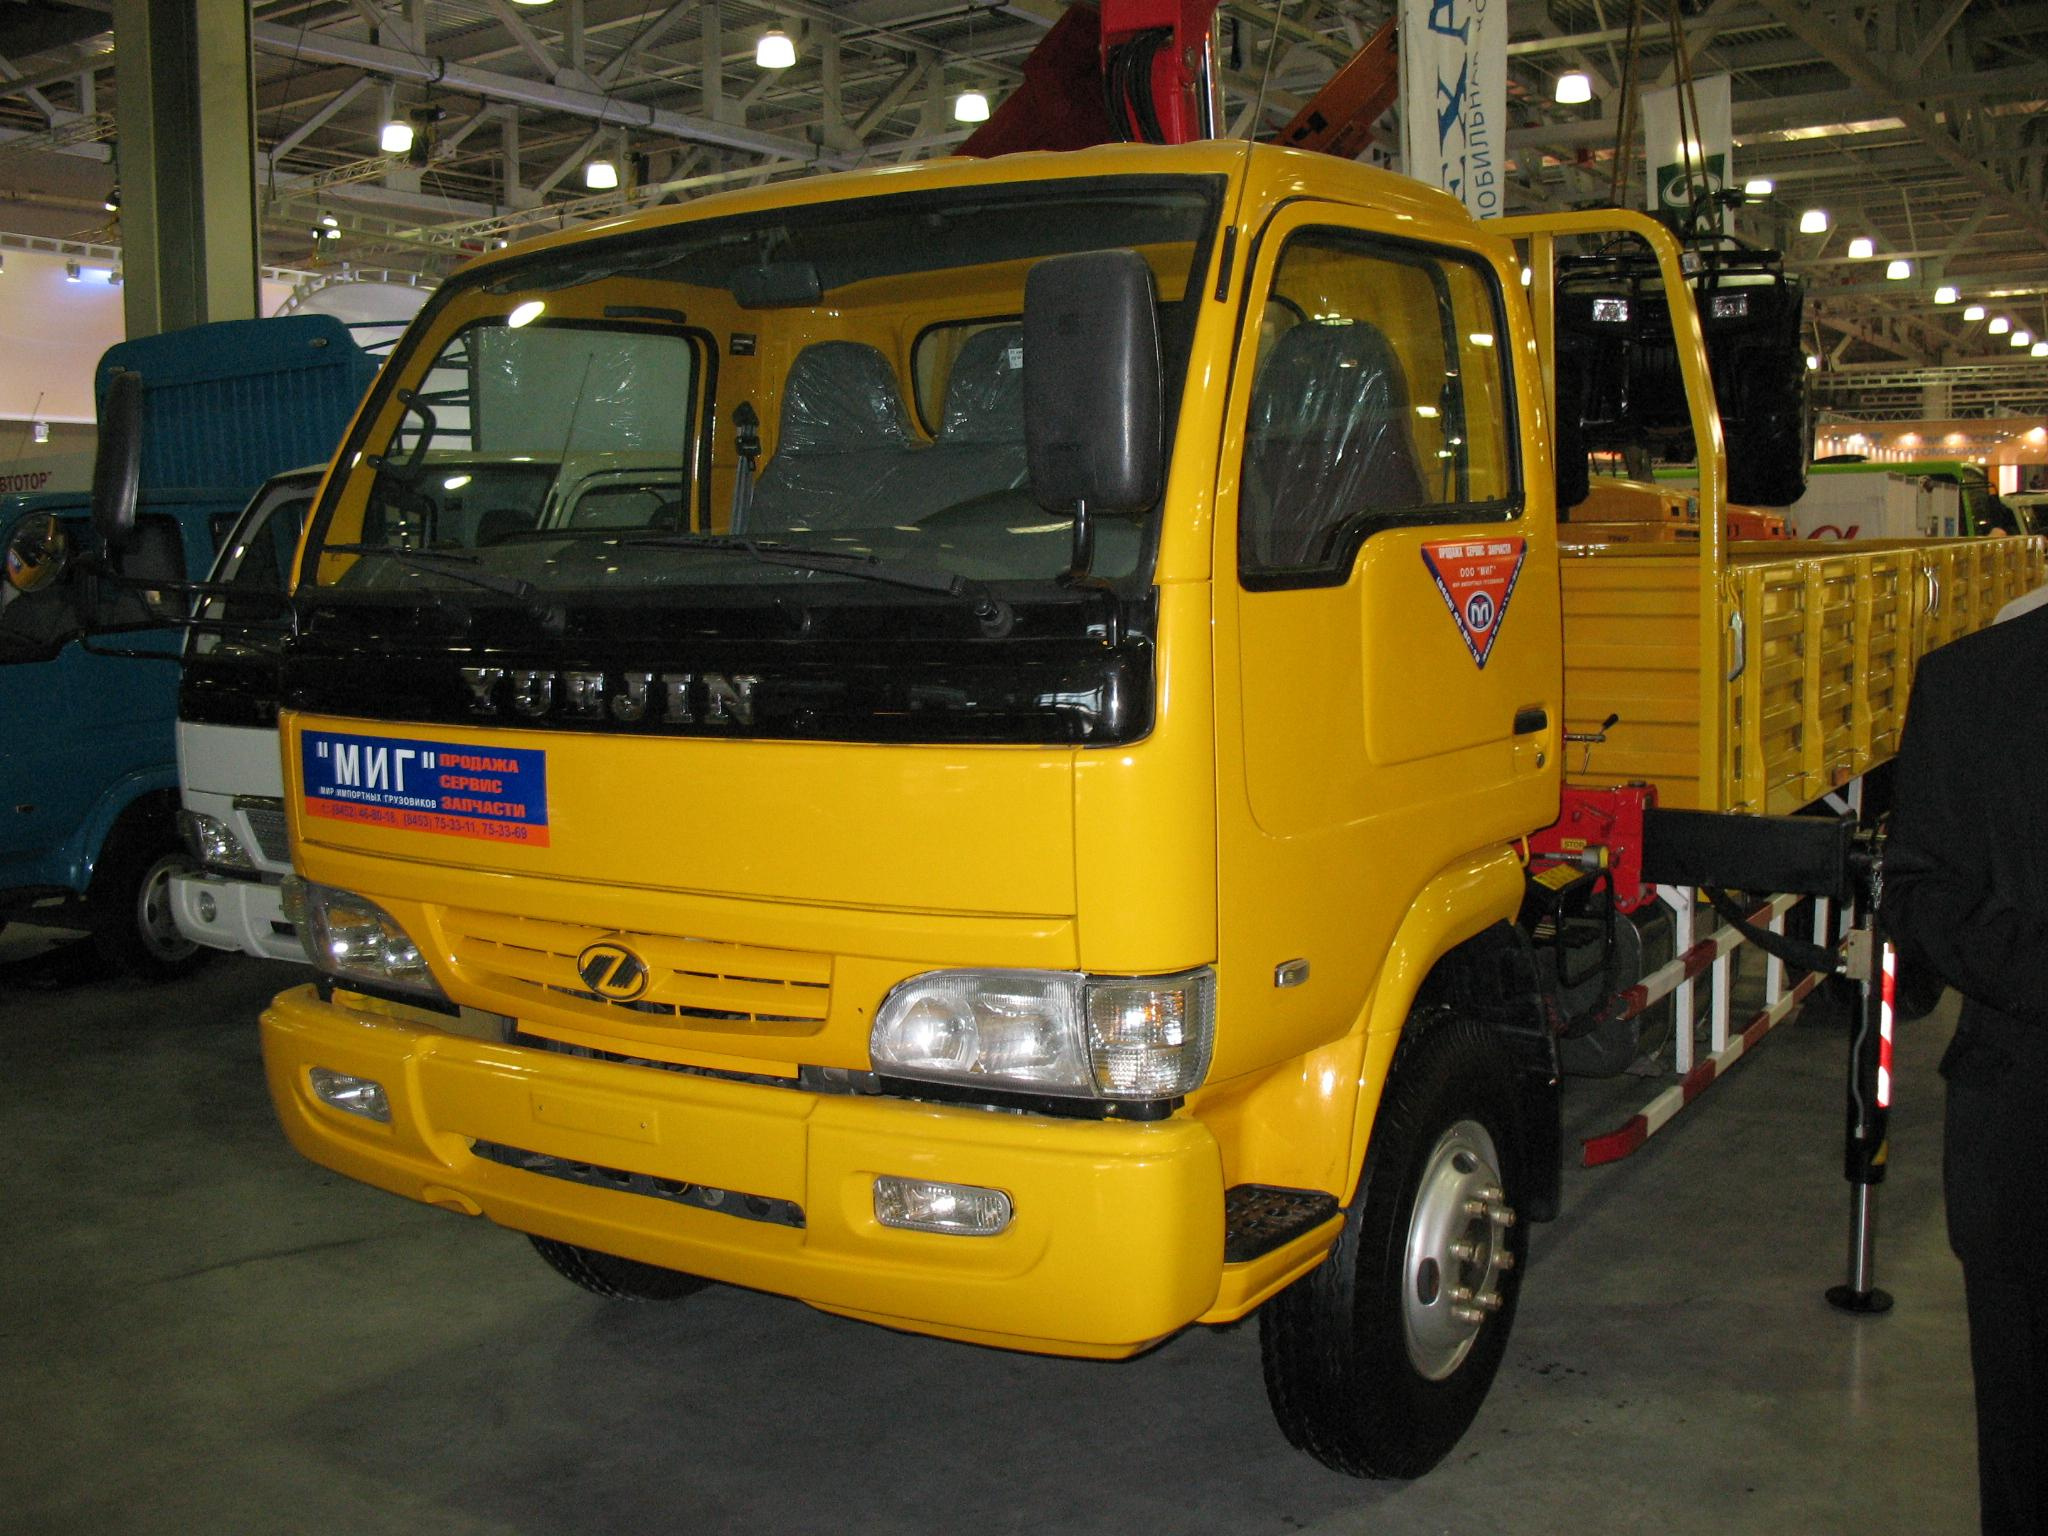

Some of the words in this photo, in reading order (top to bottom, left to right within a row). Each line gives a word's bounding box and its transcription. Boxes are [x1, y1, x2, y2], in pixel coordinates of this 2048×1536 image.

[460, 666, 759, 726] YUEJIN
[438, 753, 519, 774] ПРОДАЖА
[438, 774, 503, 794] СЕРВИС
[319, 785, 335, 796] МИР
[336, 787, 382, 803] ИМПОРТНЫХ
[384, 794, 437, 809] ГРУЗОВИКОВ
[440, 795, 526, 819] ЗАПЧАСТИ
